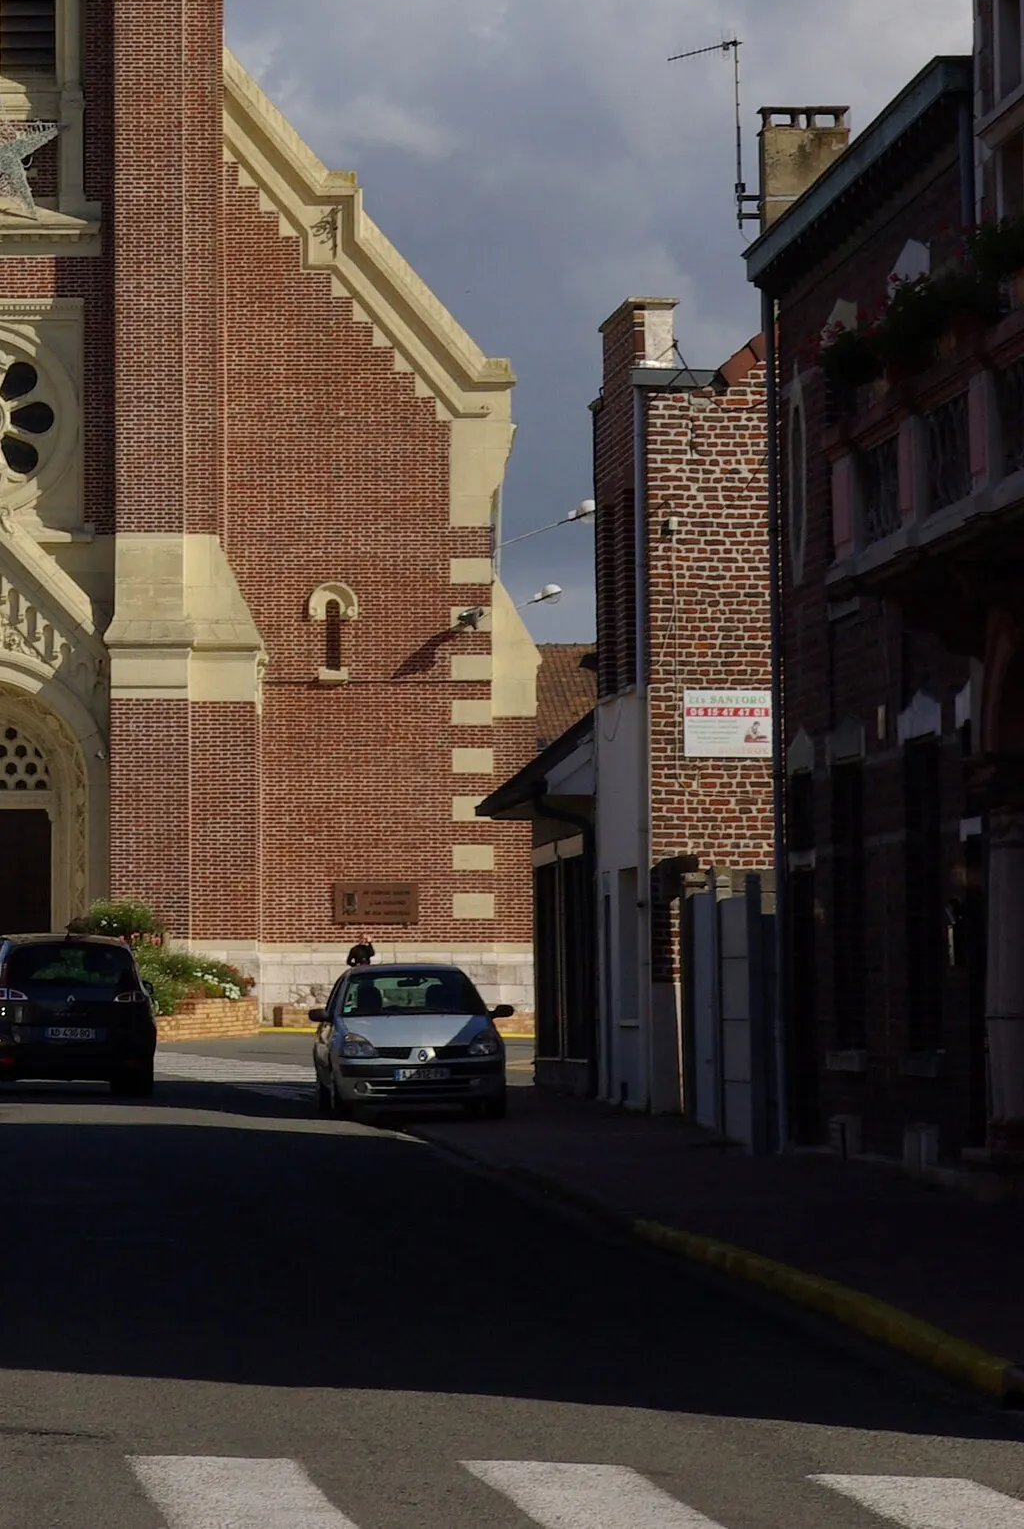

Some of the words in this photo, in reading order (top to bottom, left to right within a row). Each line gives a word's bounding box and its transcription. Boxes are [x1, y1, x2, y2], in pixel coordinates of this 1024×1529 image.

[710, 694, 766, 704] SANTORO
[689, 707, 705, 716] 06
[707, 707, 718, 716] 15
[721, 707, 734, 716] 47
[737, 707, 750, 716] 47
